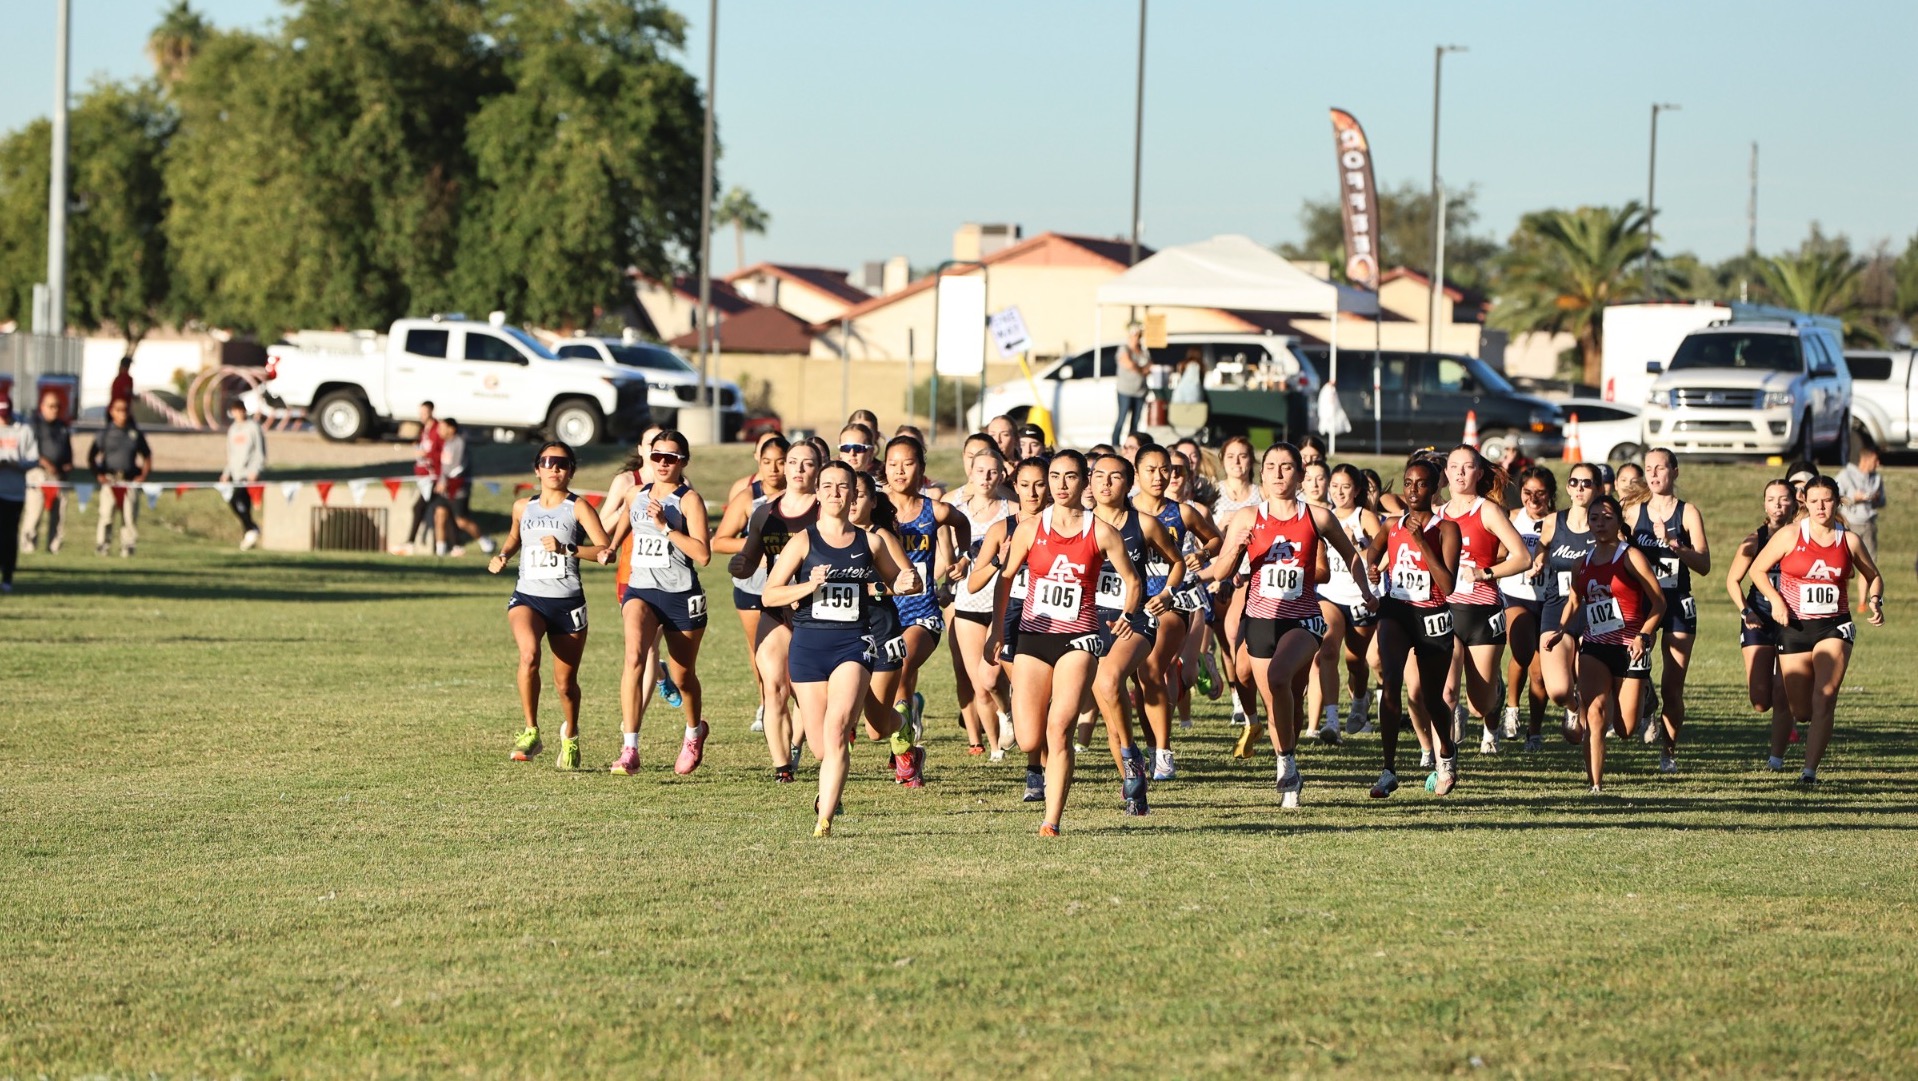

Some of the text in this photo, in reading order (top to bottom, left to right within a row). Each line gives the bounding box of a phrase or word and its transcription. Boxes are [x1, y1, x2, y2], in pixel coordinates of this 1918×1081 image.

[522, 519, 569, 532] ROYALS
[637, 537, 663, 557] 122
[531, 549, 558, 568] 125
[1096, 574, 1122, 598] 63
[1267, 567, 1298, 590] 108
[1396, 570, 1425, 591] 104
[820, 586, 854, 609] 159
[1041, 583, 1075, 609] 105
[1806, 586, 1834, 604] 106
[1590, 601, 1616, 624] 102
